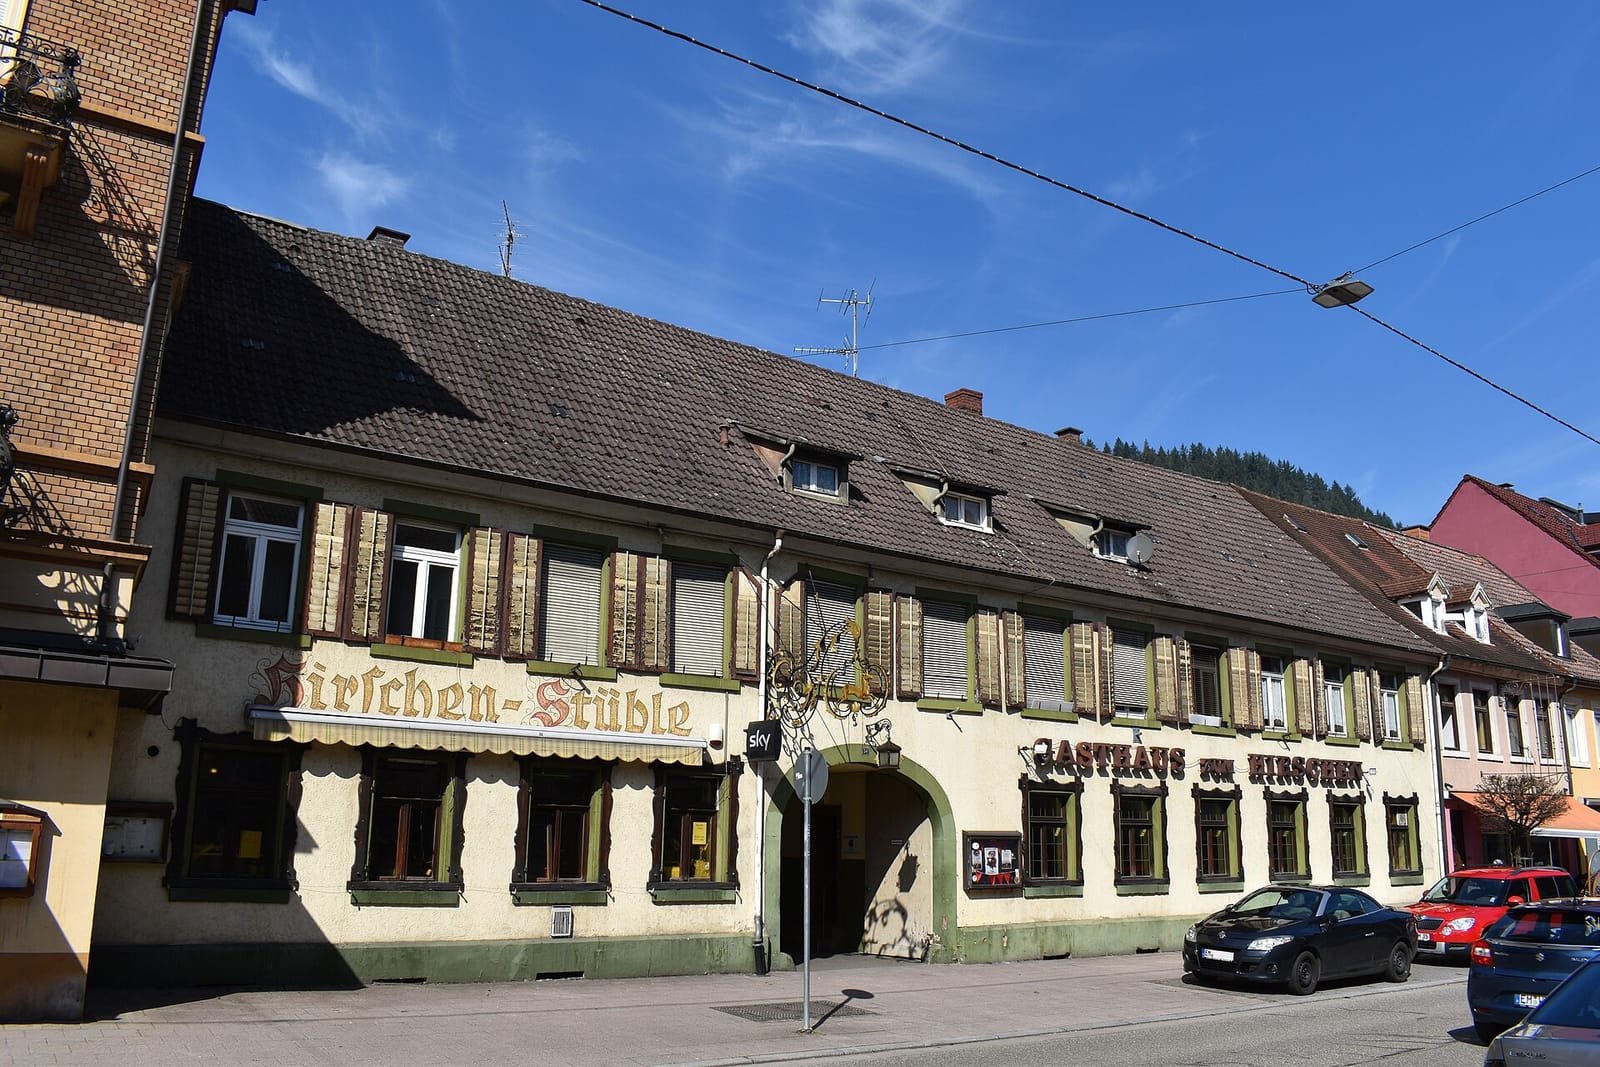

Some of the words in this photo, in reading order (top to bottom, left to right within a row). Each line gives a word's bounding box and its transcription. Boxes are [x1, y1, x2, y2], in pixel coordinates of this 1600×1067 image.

[749, 729, 771, 751] sky
[1033, 738, 1186, 770] GASTHAUS
[1248, 754, 1363, 780] HIRSCHEN
